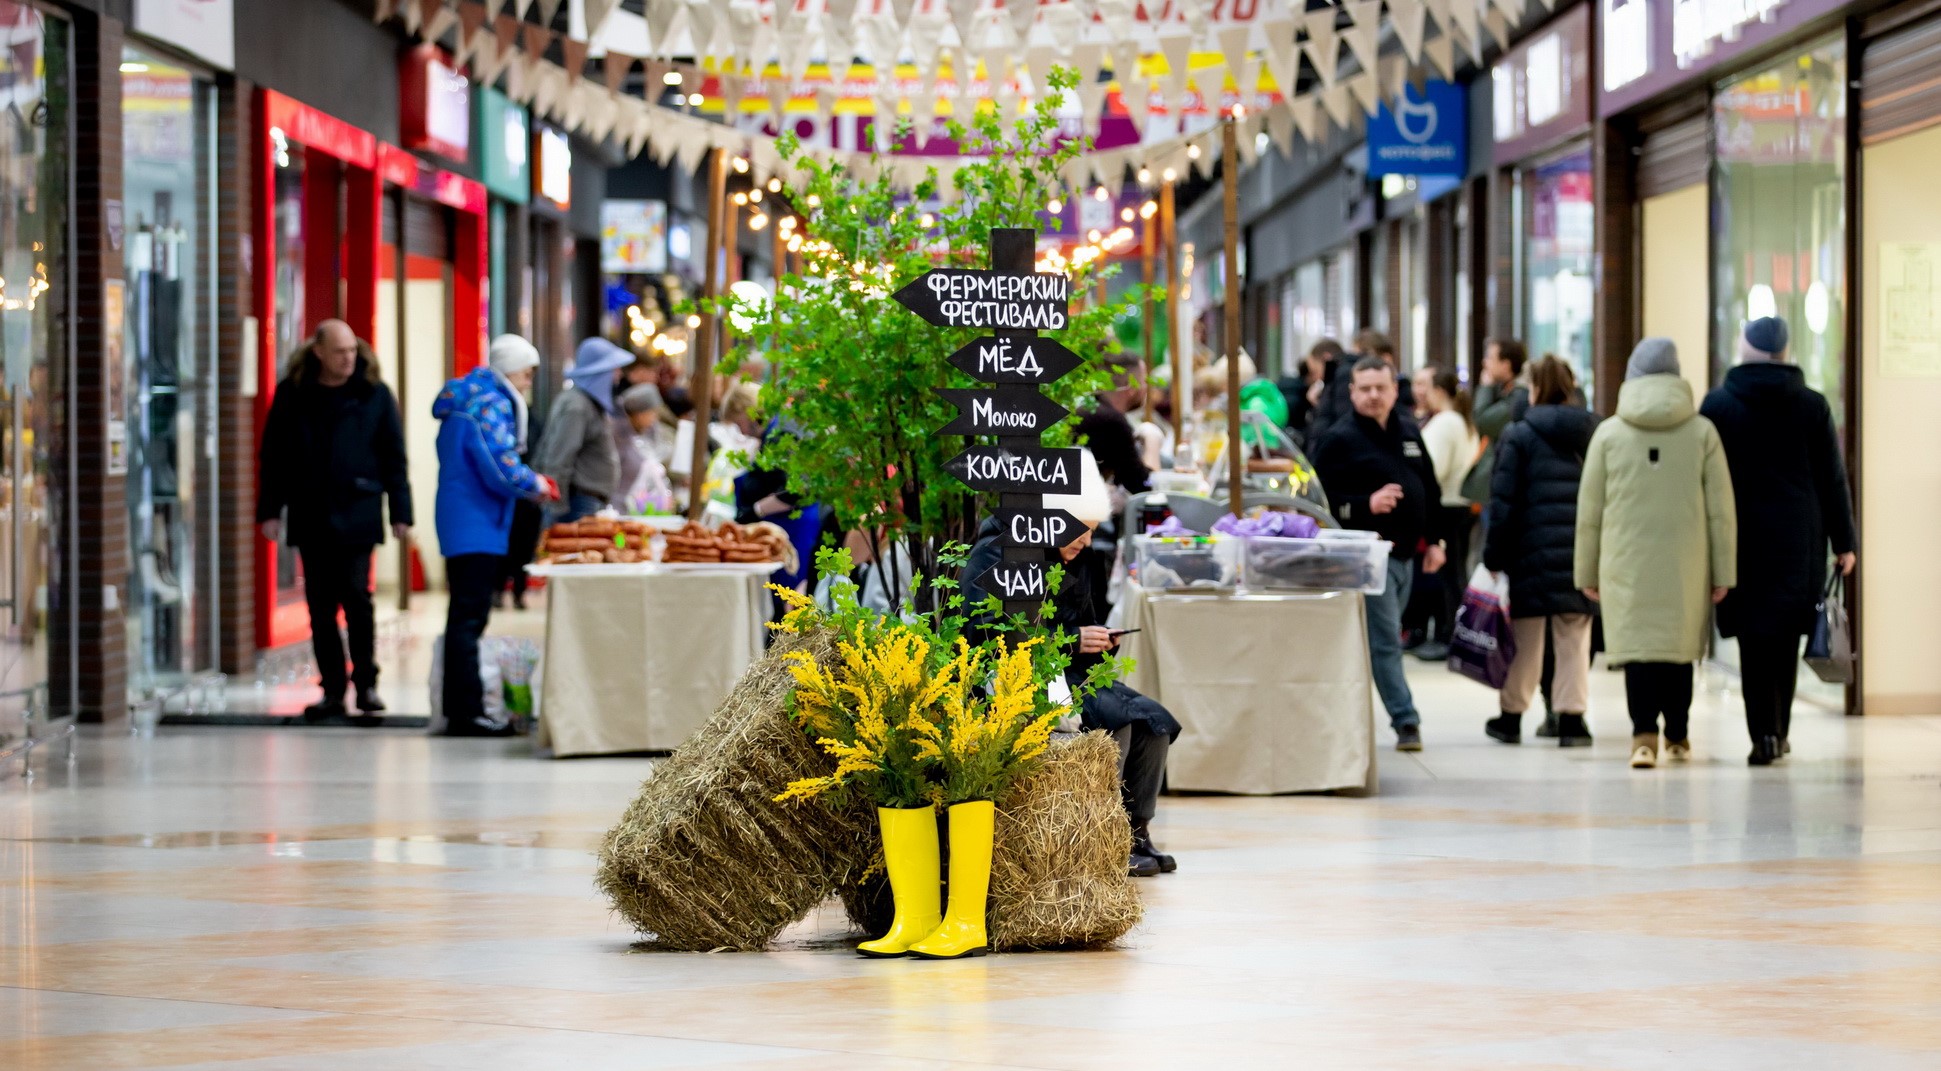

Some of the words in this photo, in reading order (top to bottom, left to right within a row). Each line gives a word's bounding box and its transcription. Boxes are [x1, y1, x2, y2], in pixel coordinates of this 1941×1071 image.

[927, 273, 1067, 303] ФЕРМЕРСКИЙ
[940, 301, 1064, 330] ФЕСТИВАЛЬ
[978, 338, 1044, 377] МЁД
[972, 397, 1037, 428] Молоко
[966, 454, 1068, 485] КОЛБАСА
[1011, 514, 1067, 546] СЫР
[993, 563, 1044, 597] ЧАЙ
